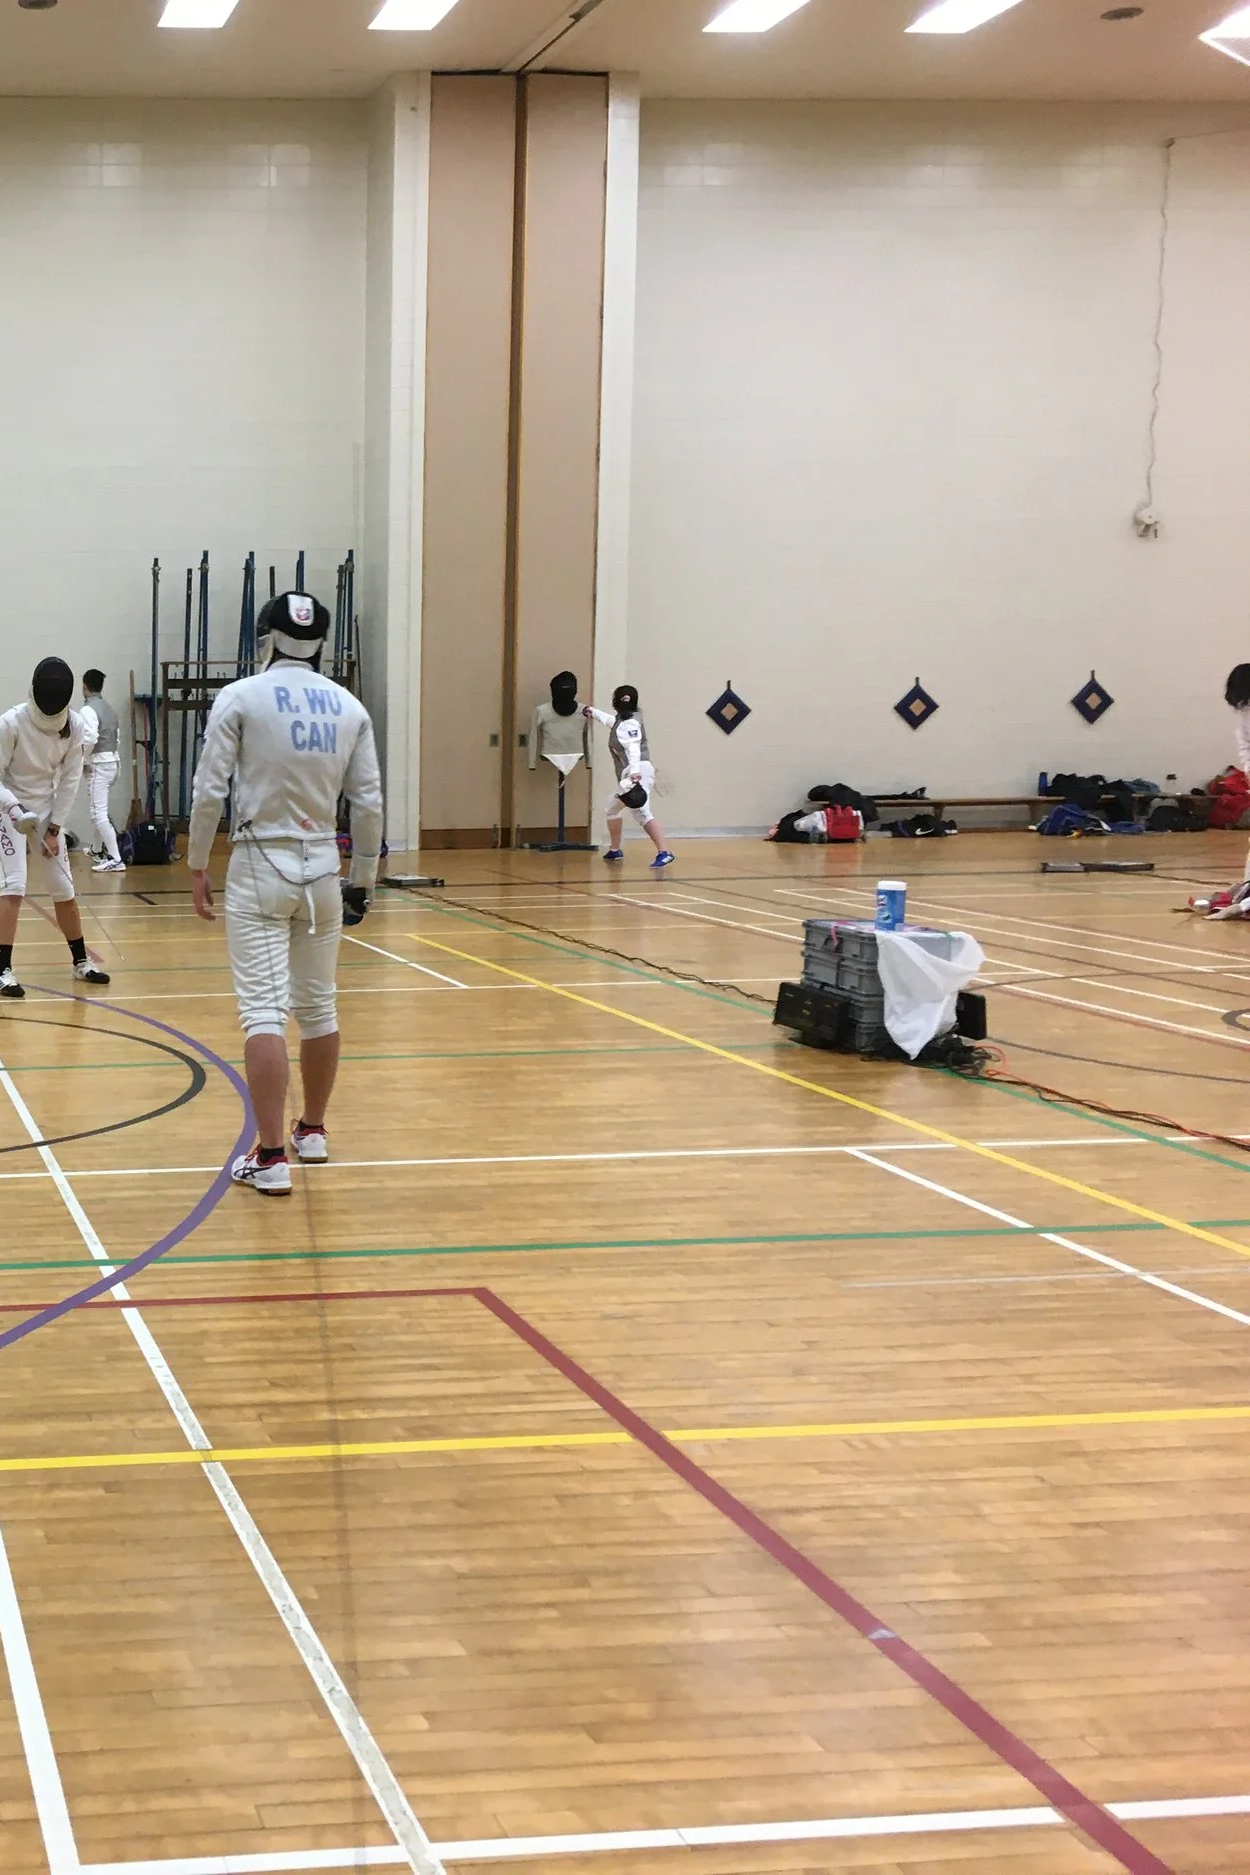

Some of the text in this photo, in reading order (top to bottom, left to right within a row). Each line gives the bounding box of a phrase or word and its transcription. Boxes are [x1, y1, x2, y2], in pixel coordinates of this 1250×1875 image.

[273, 686, 342, 716] R. WU
[290, 720, 337, 754] CAN
